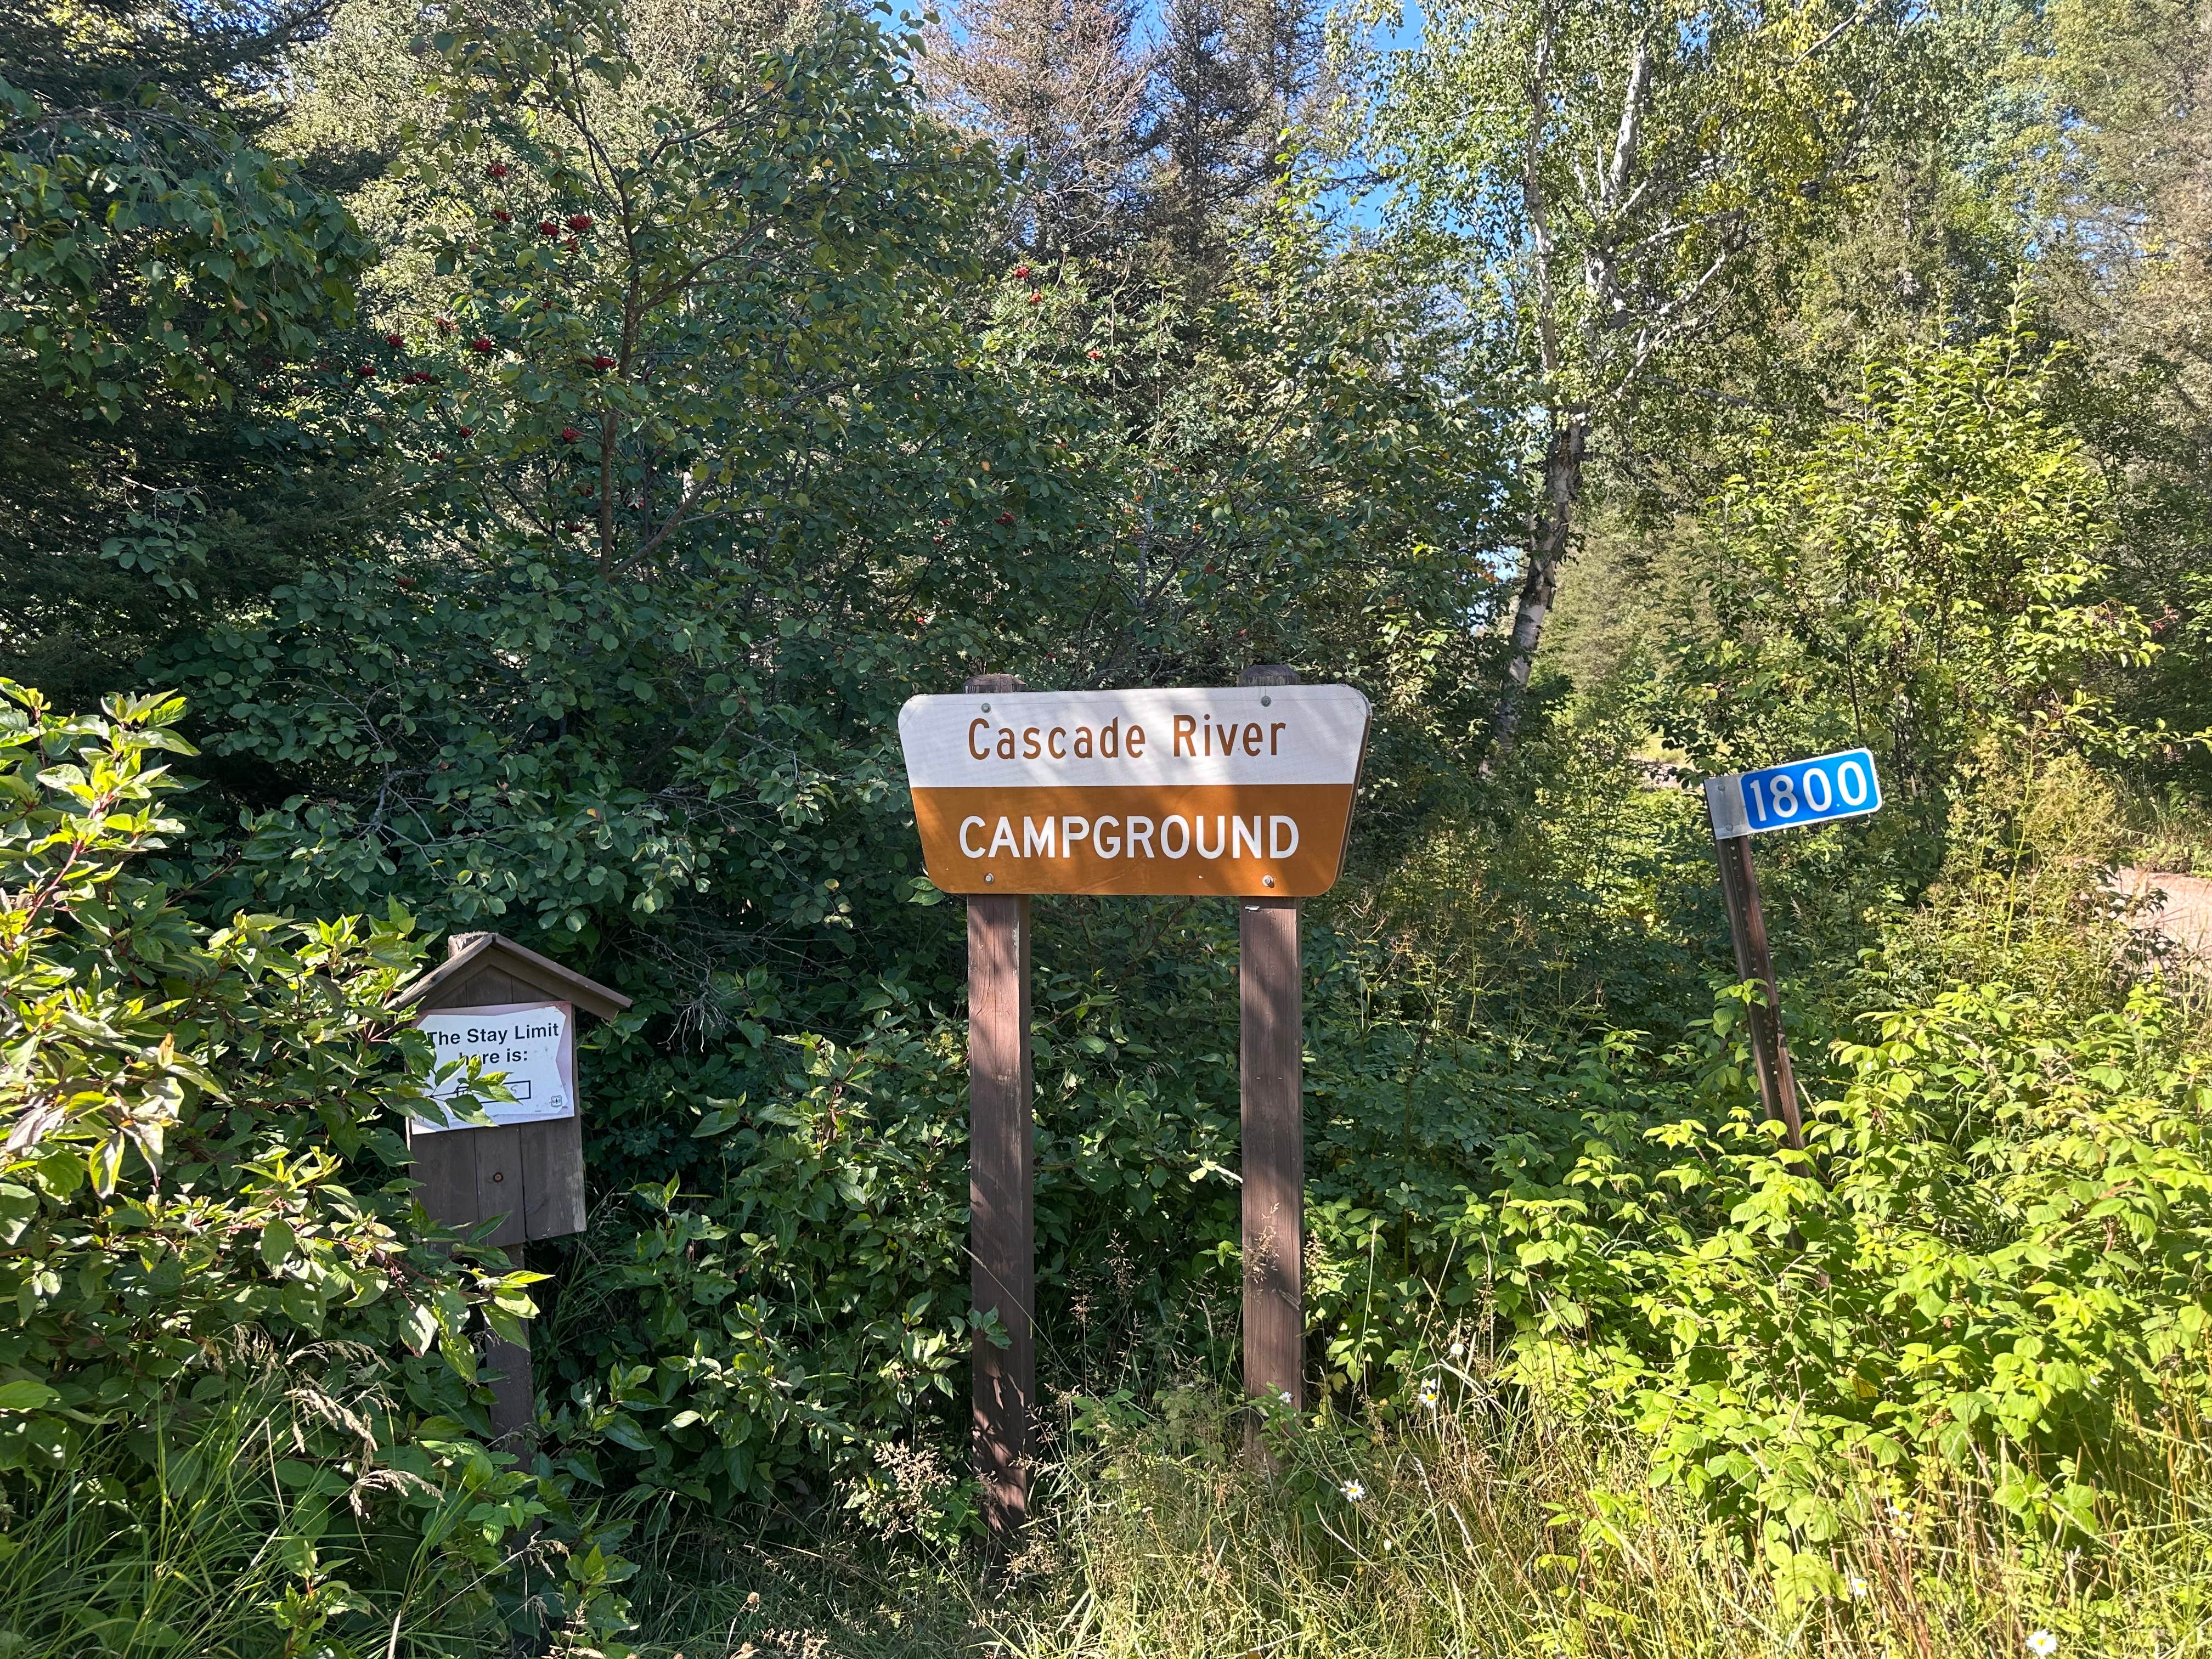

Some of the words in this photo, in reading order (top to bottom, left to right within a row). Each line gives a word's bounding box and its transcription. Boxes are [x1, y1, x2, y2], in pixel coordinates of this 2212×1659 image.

[968, 716, 1146, 760] Cascade
[1172, 714, 1286, 757] River
[1750, 760, 1867, 822] 1800
[959, 815, 1300, 860] CAMPGROUND
[427, 1031, 461, 1046] The
[467, 1027, 507, 1045] Stay
[515, 1023, 558, 1039] Limit
[459, 1052, 500, 1066] hre
[506, 1048, 528, 1063] is:
